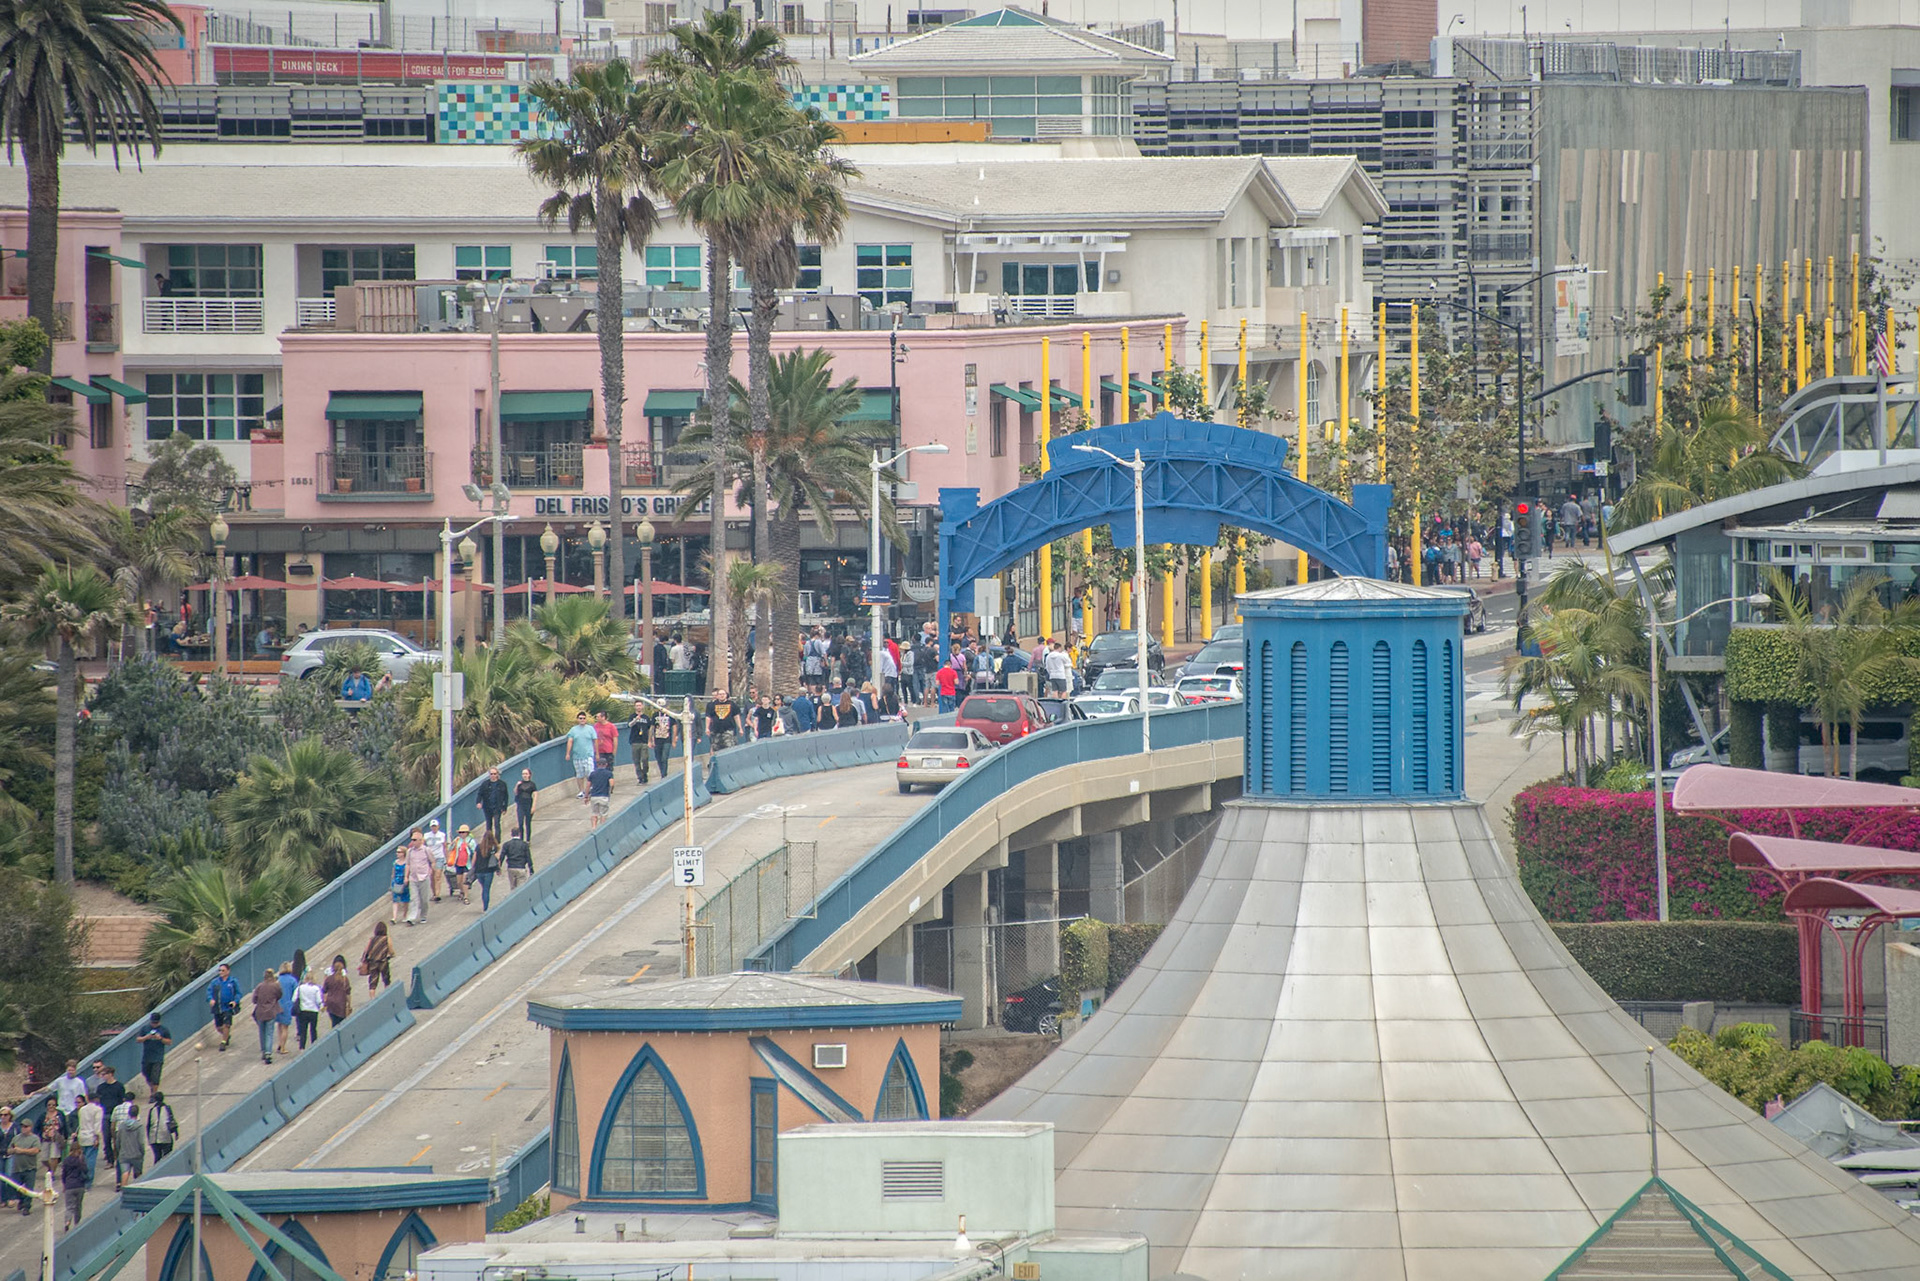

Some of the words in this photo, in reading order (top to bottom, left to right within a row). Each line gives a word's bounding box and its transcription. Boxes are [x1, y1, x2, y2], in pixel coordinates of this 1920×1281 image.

[281, 60, 313, 71] DINING
[315, 62, 339, 72] DECK
[411, 65, 431, 75] COME
[451, 66, 466, 76] FOR
[467, 66, 505, 77] SECON
[535, 497, 566, 514] DEL
[571, 497, 648, 514] FRISO'S
[683, 868, 695, 883] 5
[1018, 1265, 1034, 1279] EXIT
